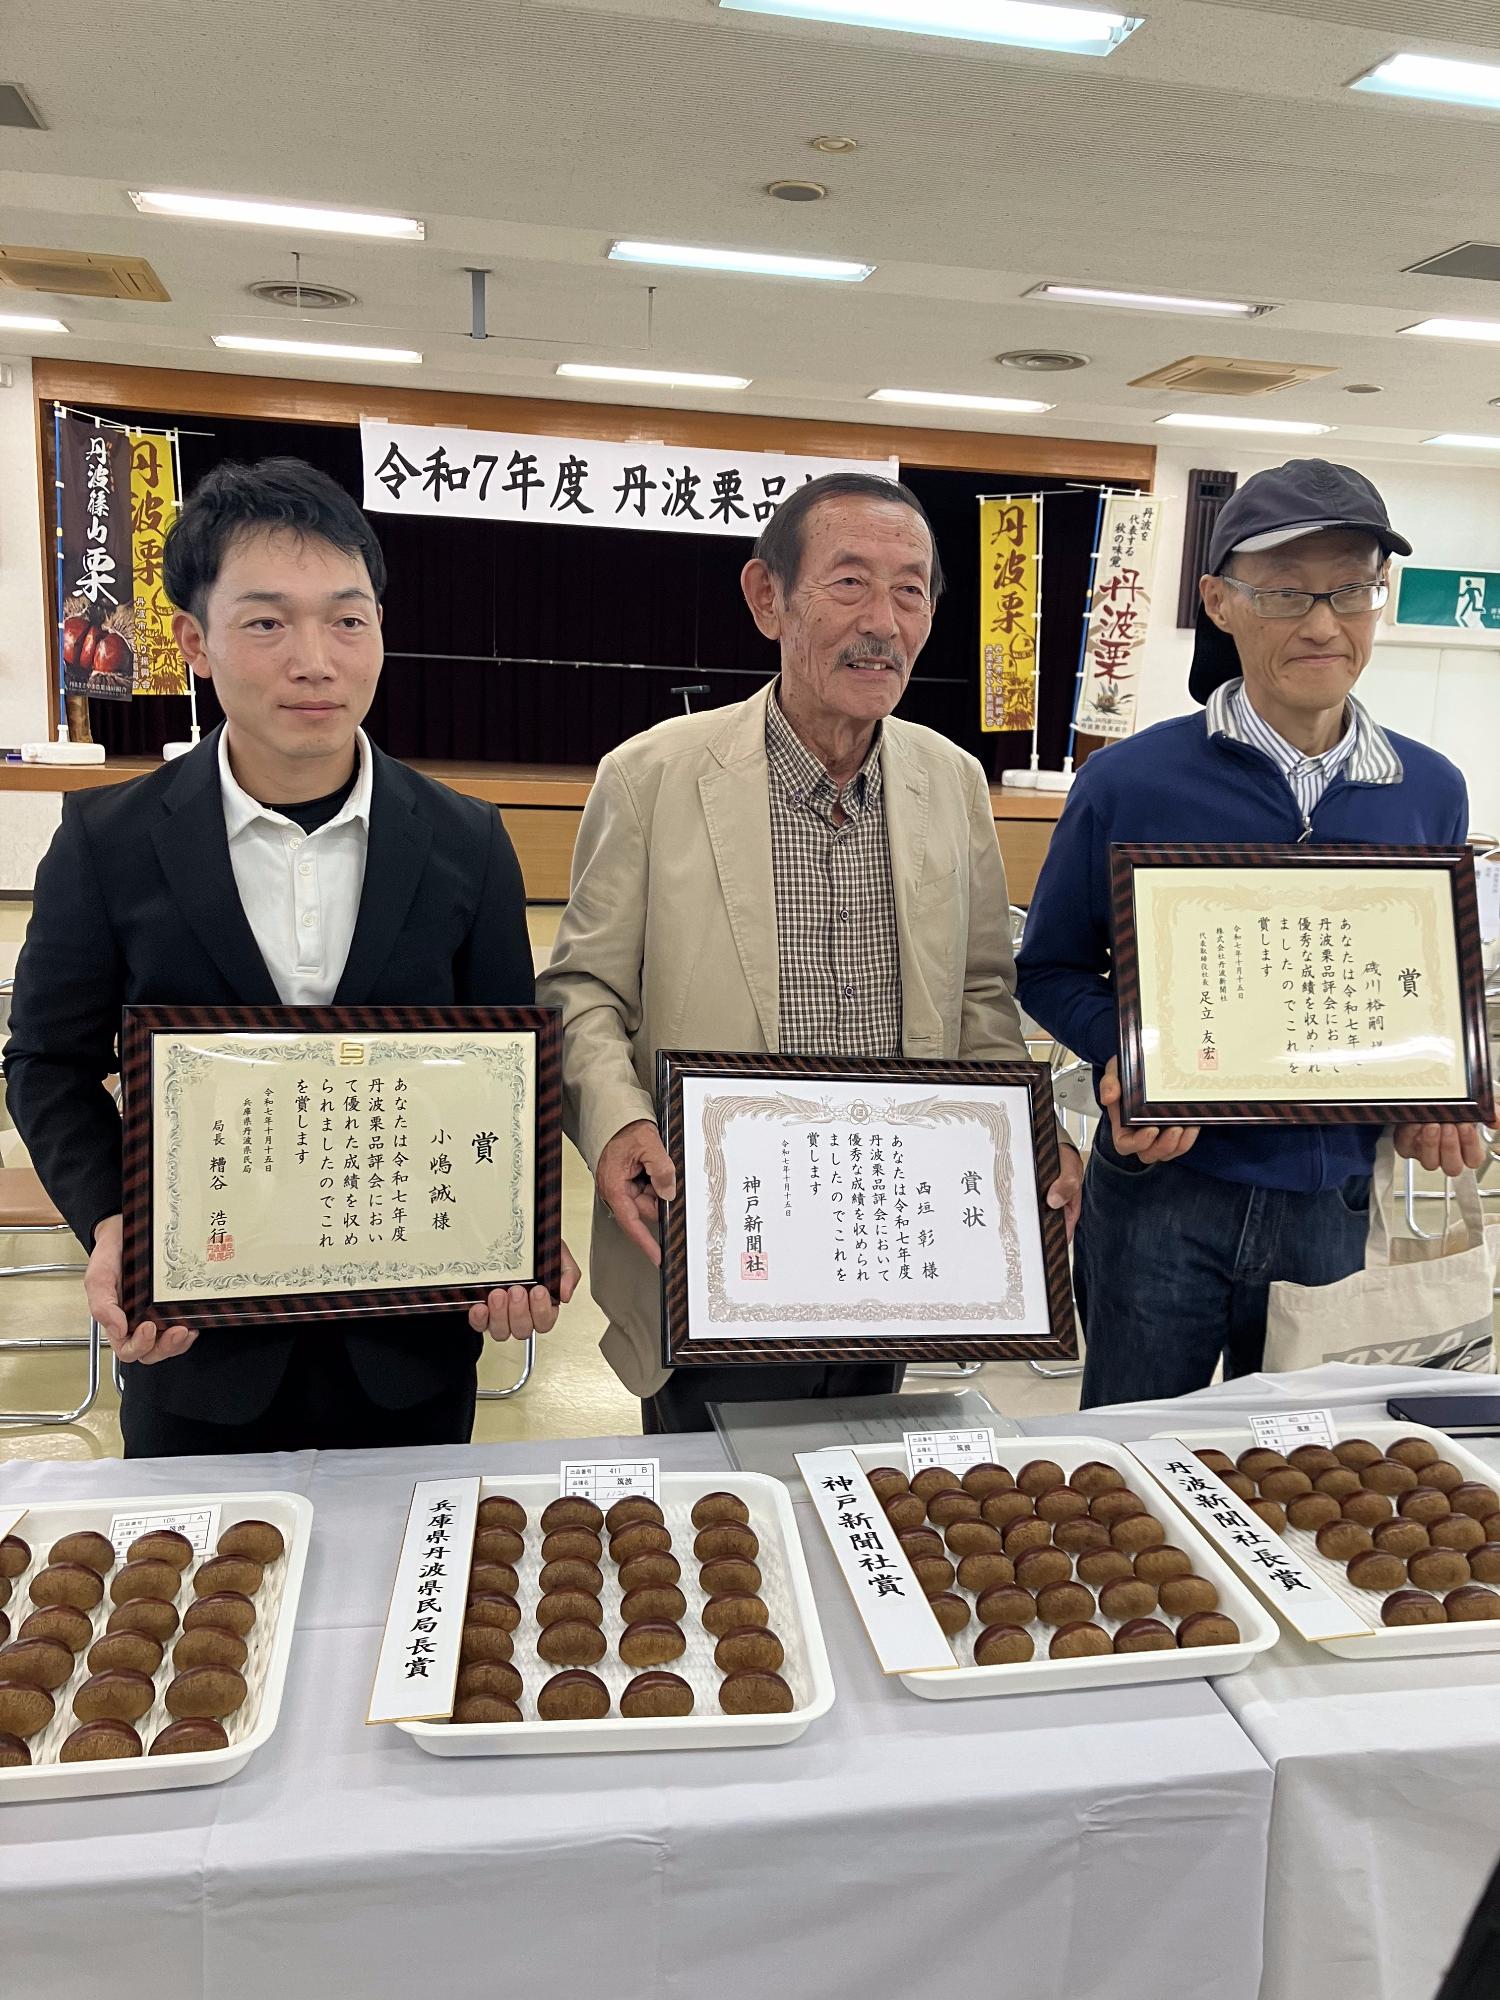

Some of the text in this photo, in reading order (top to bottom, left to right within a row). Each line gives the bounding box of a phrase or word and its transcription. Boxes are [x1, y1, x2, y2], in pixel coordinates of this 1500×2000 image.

[71, 437, 119, 606] 丹波篠山栗
[129, 439, 166, 587] 丹波栗
[374, 441, 813, 525] 令和7年度 丹波栗品
[1125, 514, 1140, 557] 代表する
[990, 504, 1028, 635] 丹波栗
[1094, 567, 1144, 685] 丹波栗
[1199, 990, 1215, 1020] 足立
[1257, 916, 1273, 978] 賞します
[1280, 917, 1299, 1074] ましたのでこれを
[1297, 916, 1321, 1074] 優秀な成績を収めれ
[1317, 917, 1342, 1073] 丹波栗品評会にお
[1339, 917, 1361, 1067] あなたは令和七年
[1397, 967, 1422, 998] 賞
[211, 1119, 226, 1147] 局長
[242, 1097, 253, 1174] 兵庫県丹波県民局
[263, 1087, 275, 1173] 令和七年十月十五日
[293, 1078, 312, 1165] を賞します
[318, 1078, 336, 1248] られましたのでこれ
[342, 1079, 361, 1247] て優れた成績を収め
[366, 1077, 386, 1243] 丹波栗品評会におい
[390, 1077, 410, 1243] あなたは令和七年度
[428, 1128, 457, 1231] 小嶋誠様
[471, 1131, 500, 1165] 賞
[781, 1139, 793, 1217] 令和七年十月十五日
[806, 1131, 822, 1196] 賞します
[209, 1210, 229, 1245] 浩行
[741, 1175, 766, 1273] 神戸新聞社
[829, 1132, 848, 1282] ましたのでこれを
[847, 1132, 871, 1282] 優秀な成績を収められ
[868, 1134, 891, 1282] 丹波栗品評会において
[891, 1134, 914, 1281] あなたは令和七年度
[960, 1170, 988, 1229] 賞状
[820, 1475, 906, 1597] 神戸新聞社賞
[1163, 1459, 1312, 1592] 丹波新聞社長賞
[404, 1498, 457, 1680] 兵庫県丹波県民局長賞
